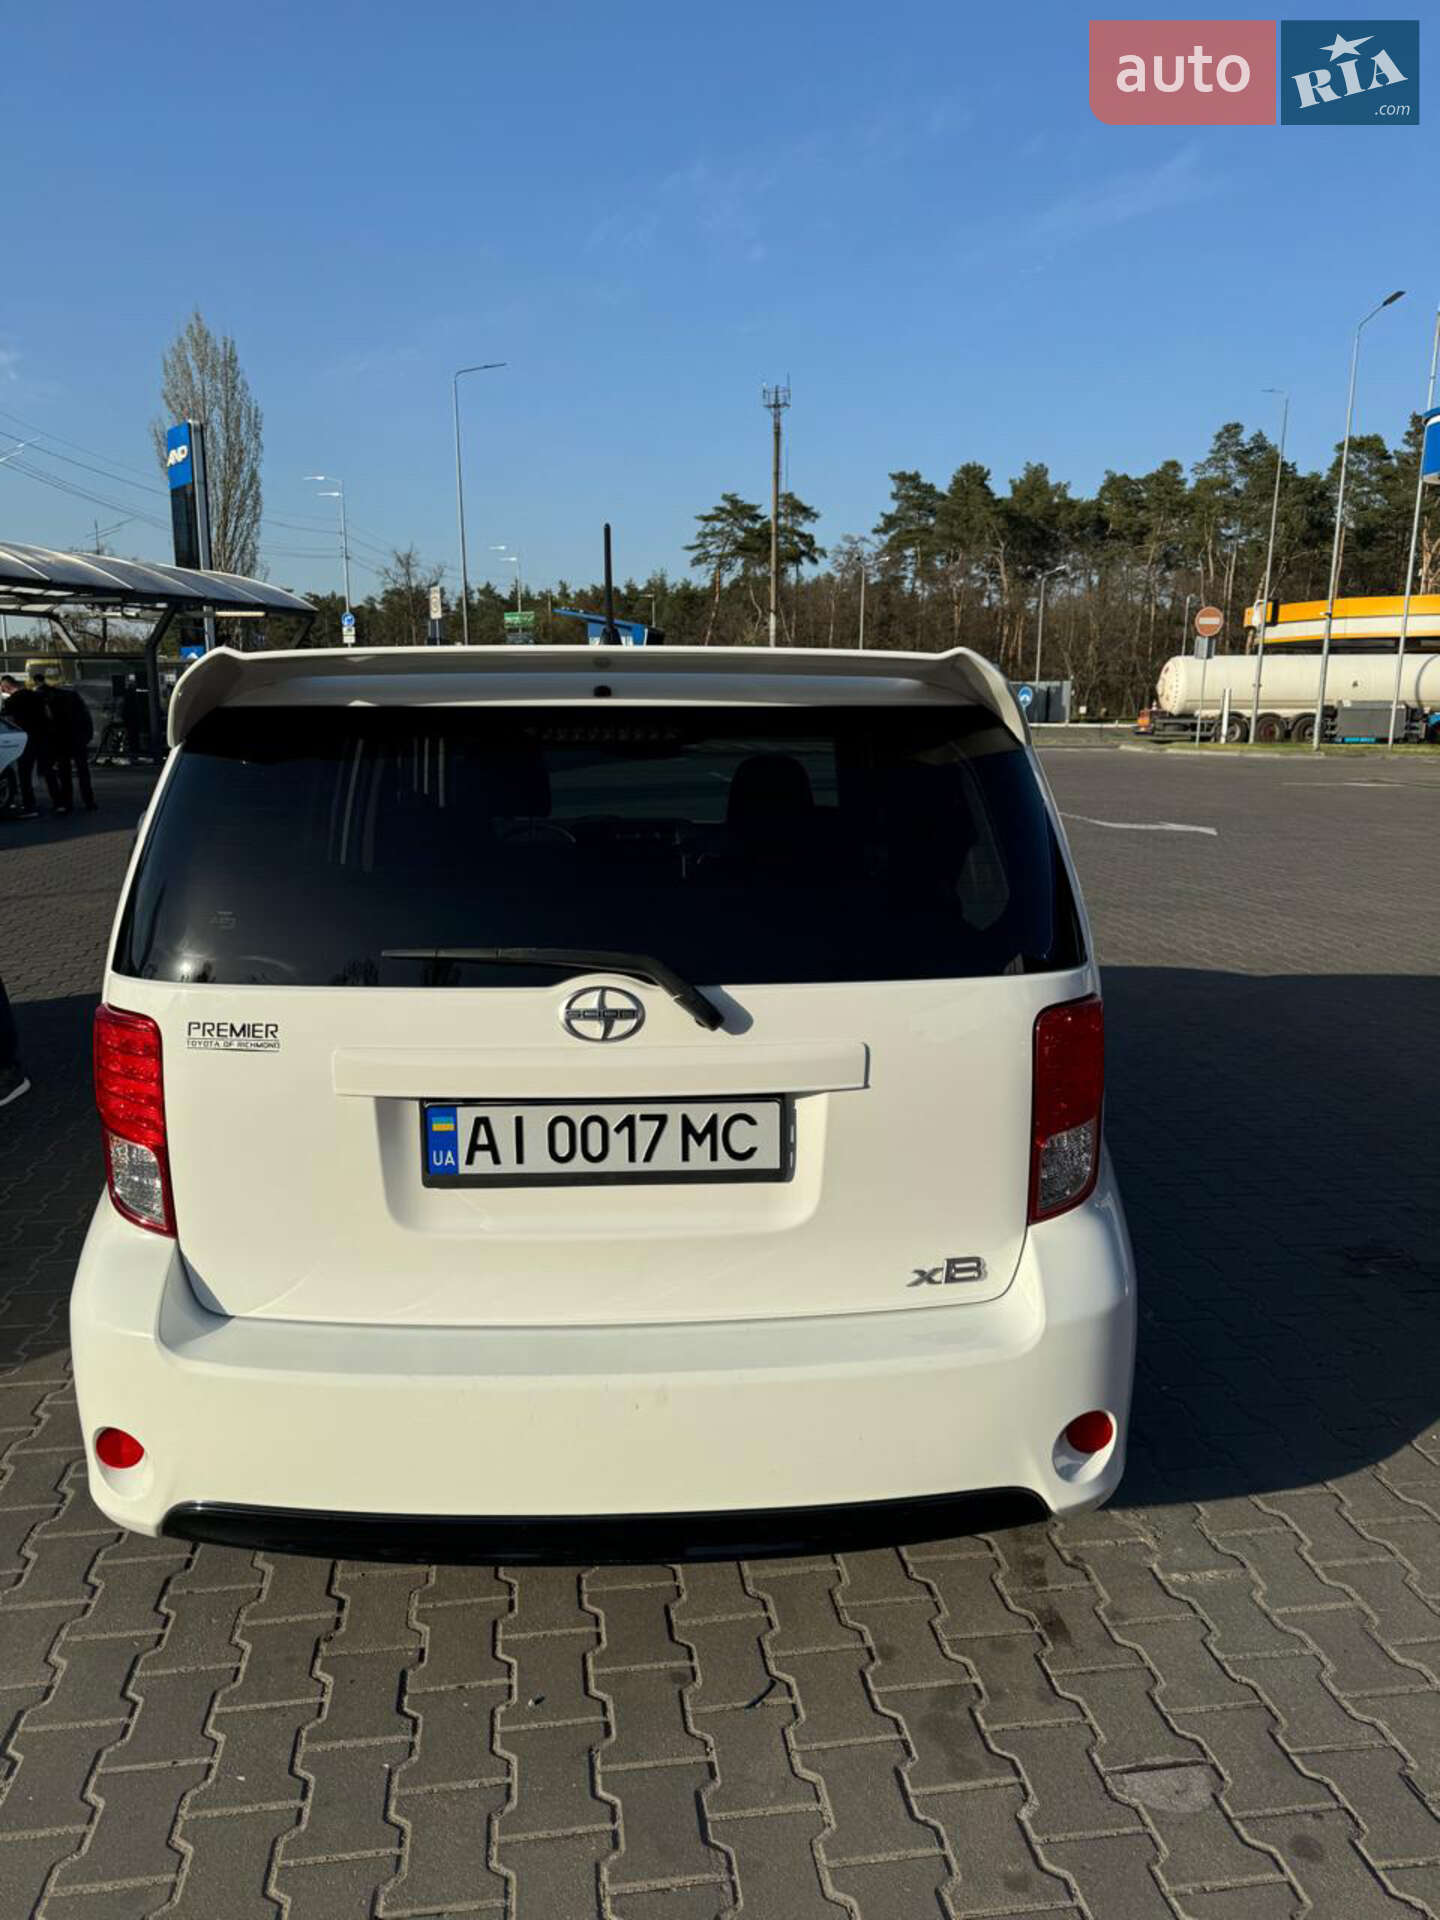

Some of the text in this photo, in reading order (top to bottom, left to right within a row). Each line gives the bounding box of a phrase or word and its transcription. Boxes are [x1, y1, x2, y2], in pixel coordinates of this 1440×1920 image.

[187, 1021, 279, 1039] PREMIER
[187, 1039, 280, 1049] TOYOTA OF RICHMOND
[465, 1112, 758, 1165] AI 0017 MC
[432, 1150, 456, 1166] UA
[906, 1256, 987, 1287] xB
